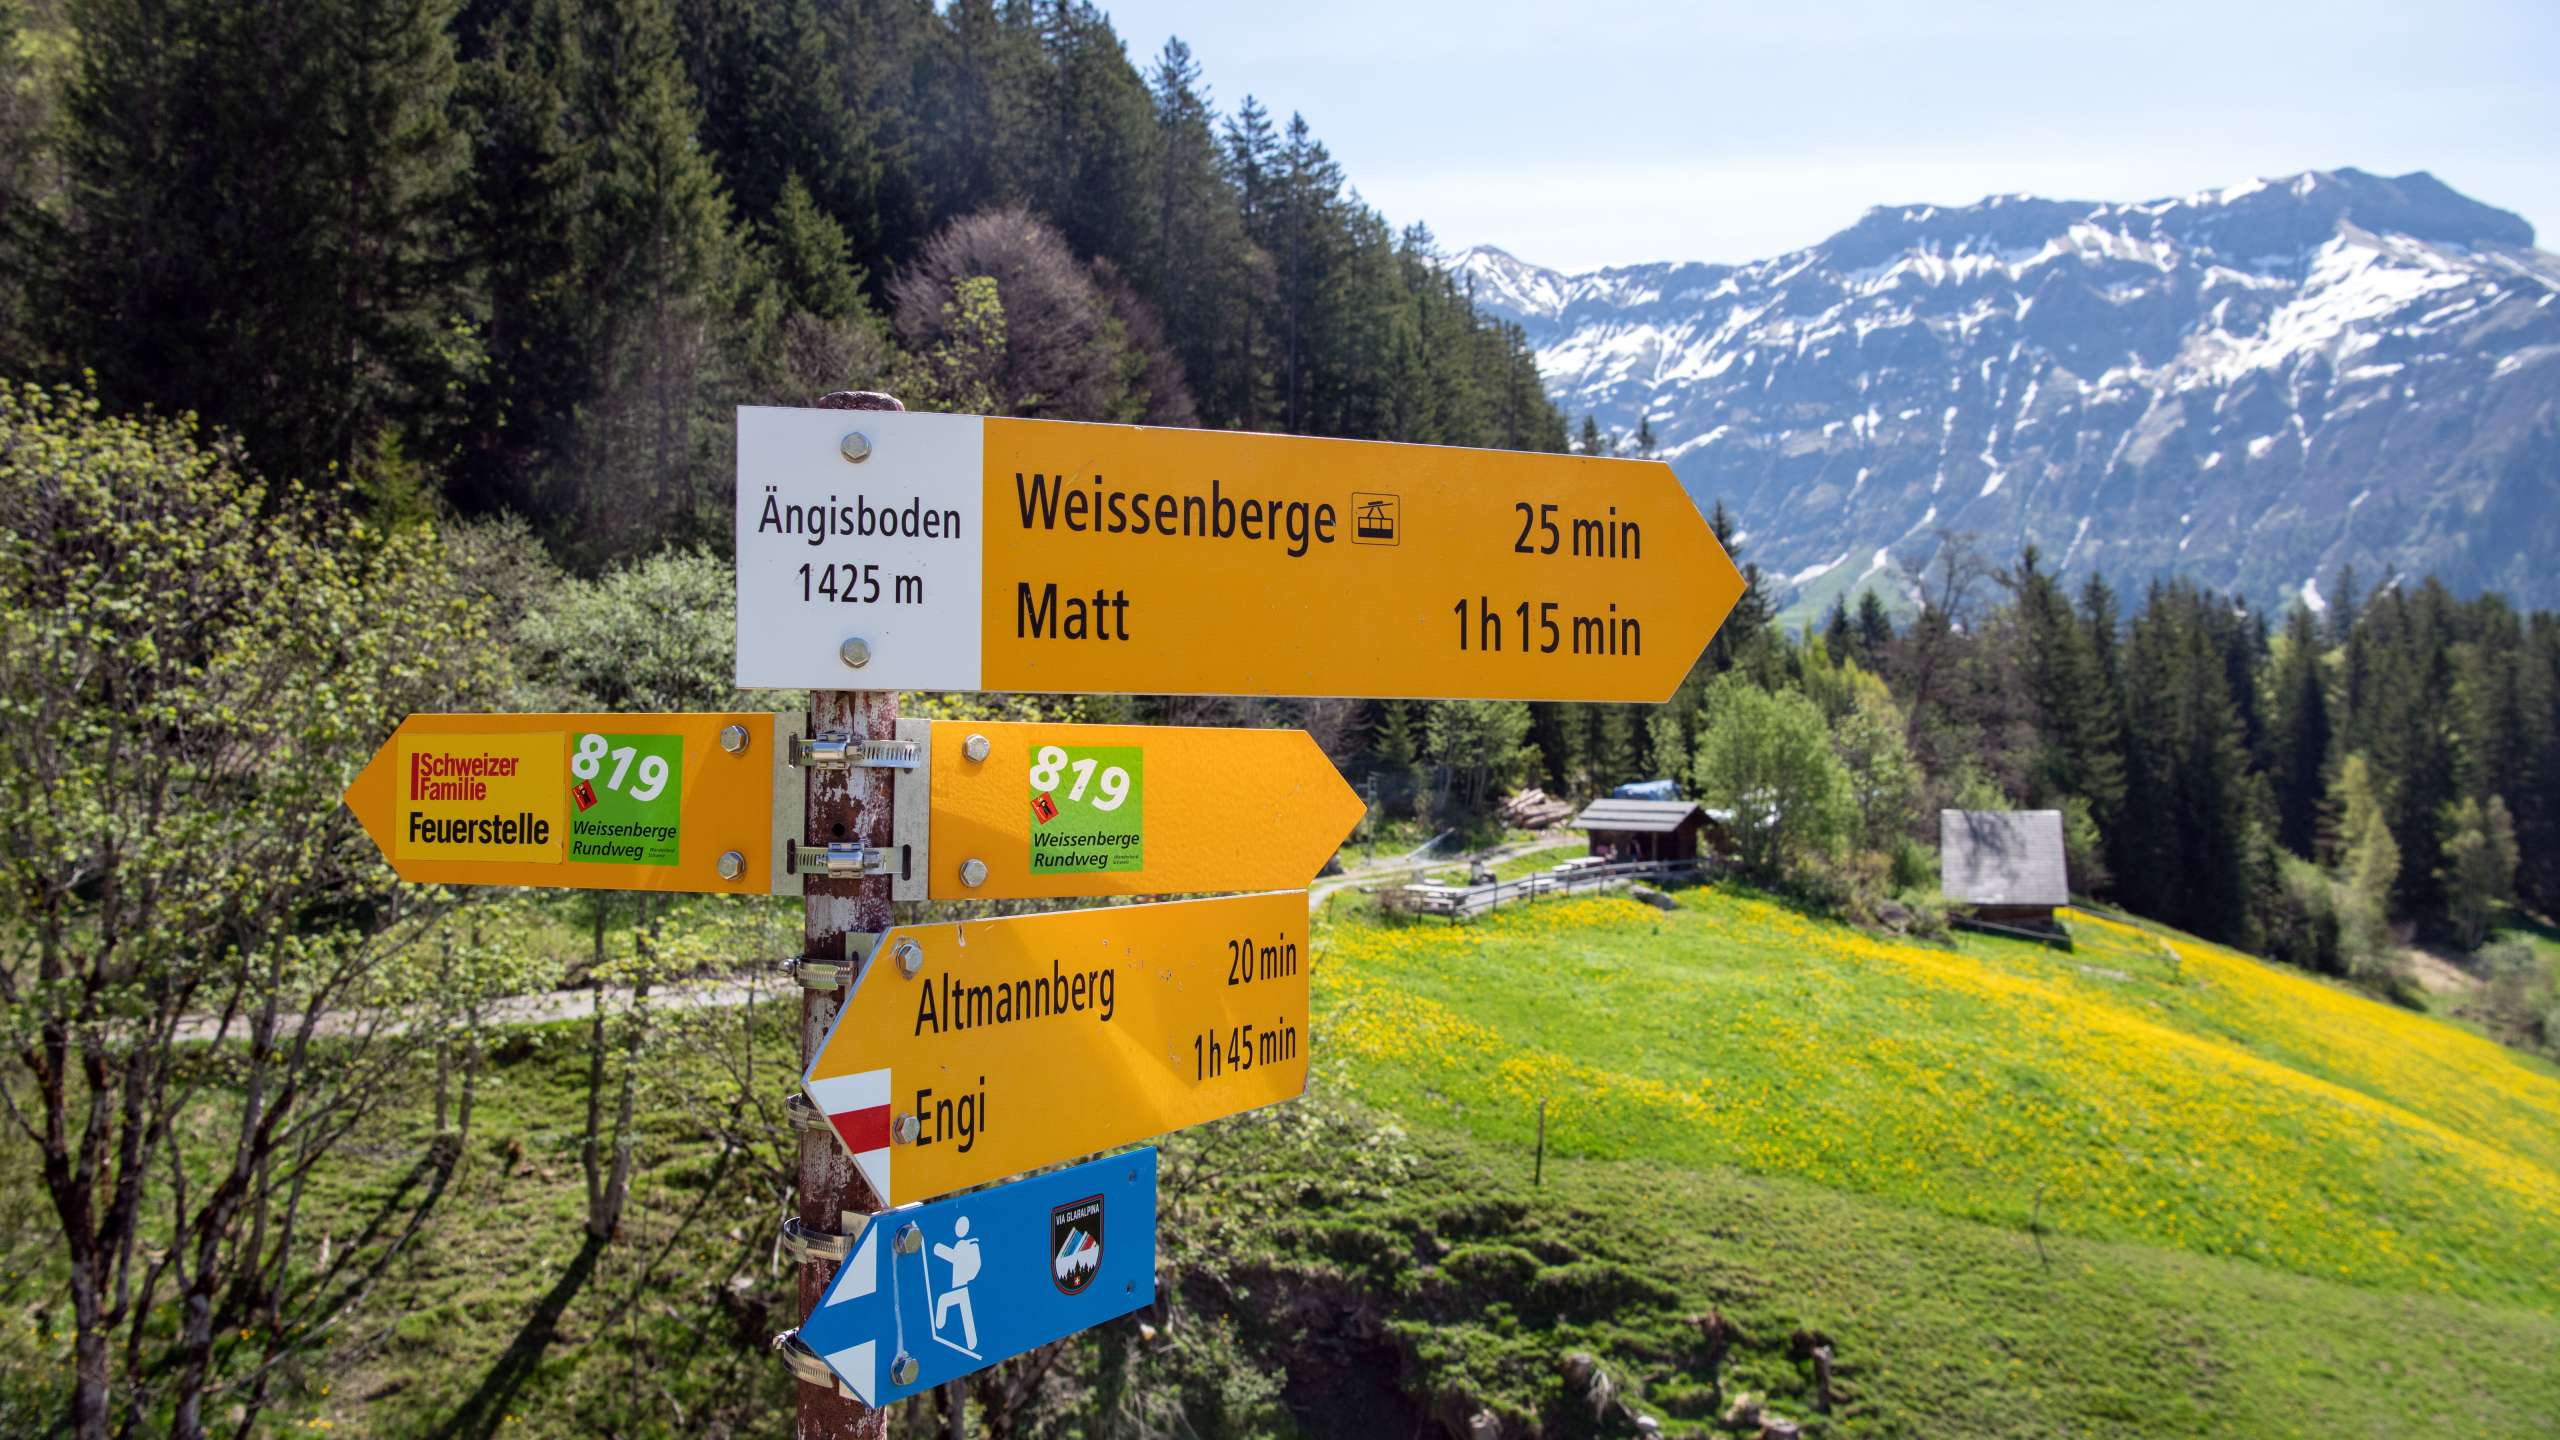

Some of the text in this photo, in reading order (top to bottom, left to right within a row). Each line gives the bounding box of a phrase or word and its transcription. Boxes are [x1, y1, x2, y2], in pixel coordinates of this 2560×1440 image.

[758, 485, 961, 547] Ängisboden
[1015, 472, 1641, 560] Weissenberge 25 min
[798, 562, 923, 605] 1425 m
[1017, 581, 1130, 641] Matt
[1516, 601, 1560, 654] 15
[1572, 603, 1641, 656] min
[420, 752, 519, 777] Schweizer
[571, 733, 669, 802] 819
[1029, 746, 1130, 811] 819
[420, 777, 487, 801] Familie
[409, 811, 549, 845] Feuerstelle
[572, 820, 677, 842] Weissenberge
[1034, 831, 1140, 849] Weissenberge
[572, 840, 644, 861] Rundweg
[1034, 851, 1108, 869] Rundweg
[914, 932, 1297, 1037] Altmannberg 20 min
[915, 1075, 985, 1154] Engi
[1227, 1024, 1253, 1072] 45
[1259, 1016, 1296, 1066] min
[1056, 1214, 1065, 1226] VIA
